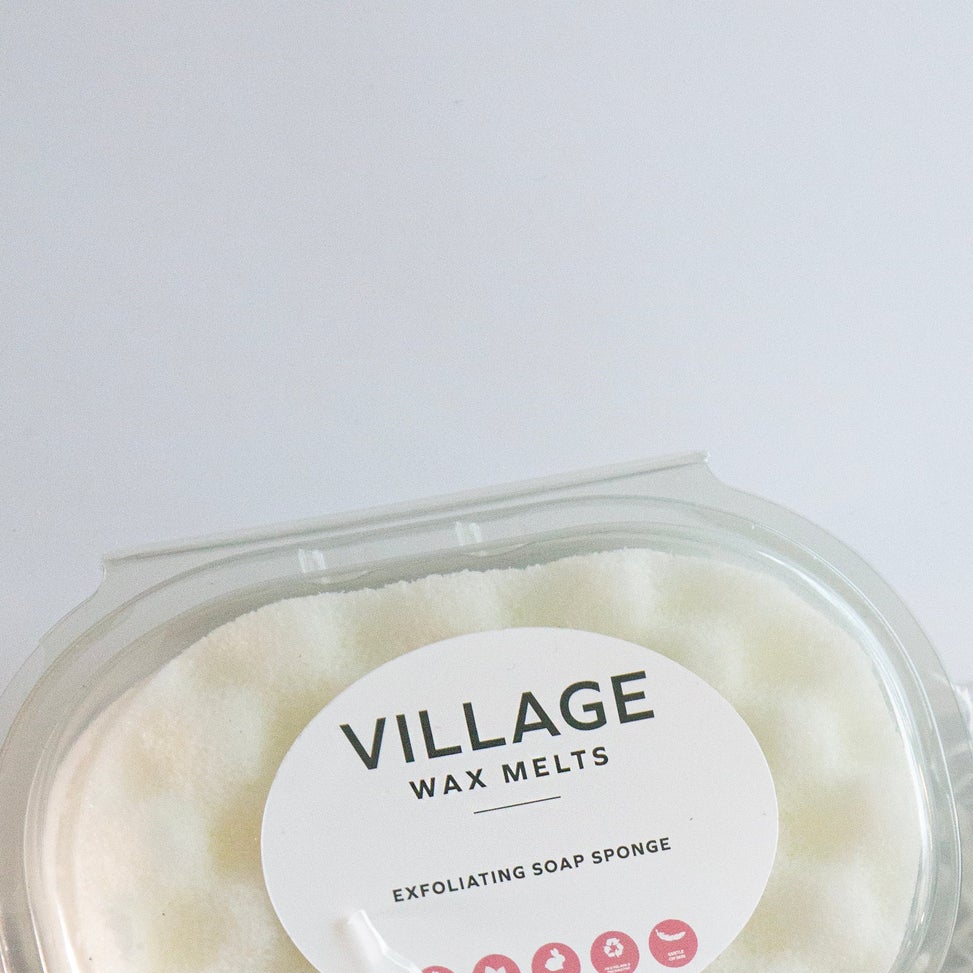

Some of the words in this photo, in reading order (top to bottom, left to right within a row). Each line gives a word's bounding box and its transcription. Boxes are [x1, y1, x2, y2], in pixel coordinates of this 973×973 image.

[339, 670, 656, 771] VILLAGE
[409, 768, 488, 800] WAX
[501, 746, 611, 785] MELTS
[392, 865, 526, 902] EXFOLIATING
[532, 854, 585, 877] SOAP
[591, 837, 672, 865] SPONGE
